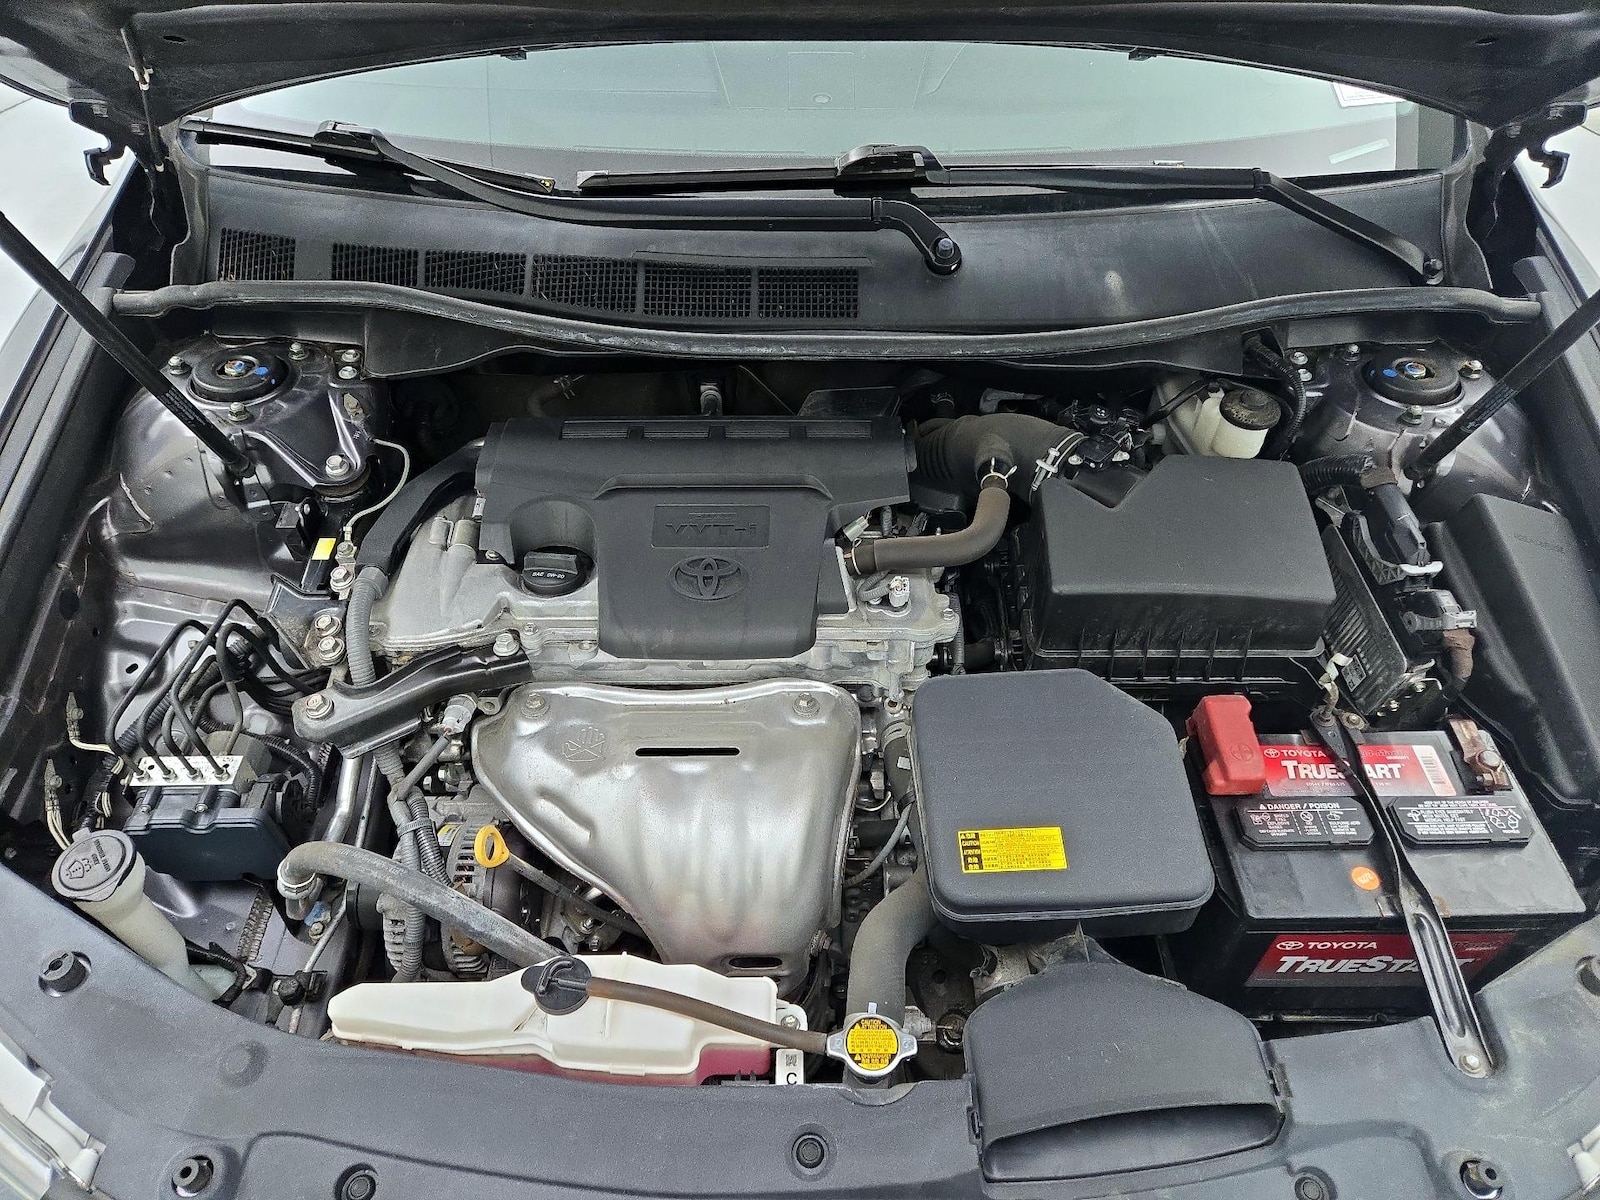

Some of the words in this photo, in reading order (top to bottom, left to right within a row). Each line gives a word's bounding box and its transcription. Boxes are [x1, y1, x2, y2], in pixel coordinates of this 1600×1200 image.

[546, 572, 566, 580] 0W-20
[1281, 749, 1327, 758] TOYOTA
[1308, 941, 1378, 950] TOYOTA
[786, 1072, 797, 1085] C
